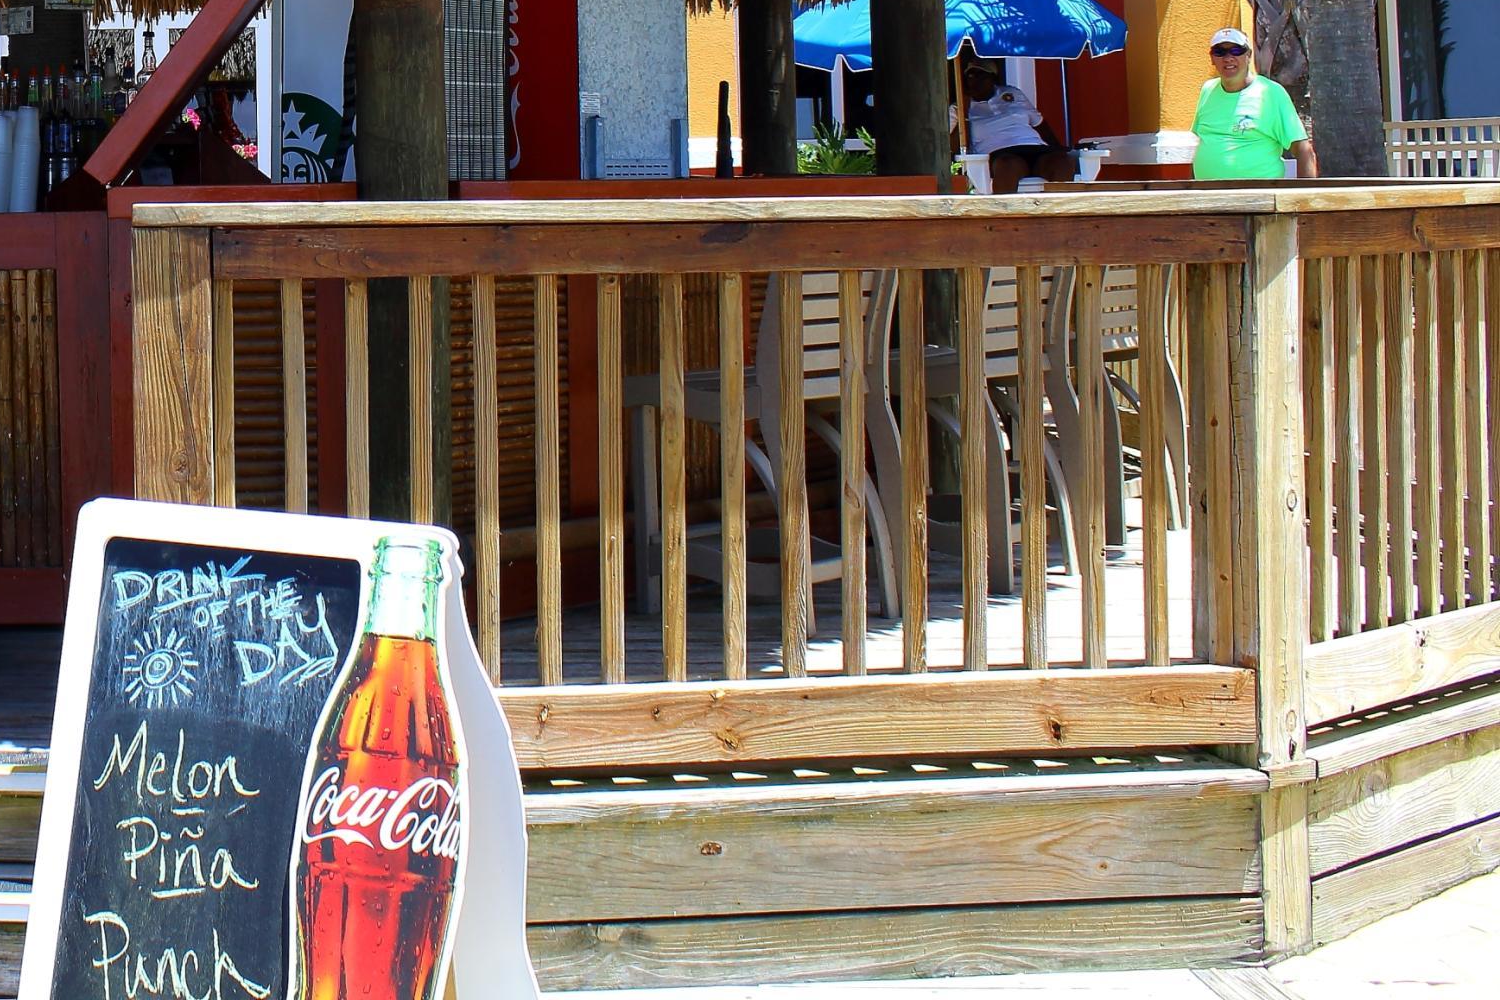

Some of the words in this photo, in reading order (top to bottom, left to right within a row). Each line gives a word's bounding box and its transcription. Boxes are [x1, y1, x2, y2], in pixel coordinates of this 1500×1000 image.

[112, 556, 266, 612] DRINK
[192, 601, 230, 629] OF
[238, 577, 303, 622] THE
[233, 592, 338, 686] DAY
[94, 720, 260, 801] Melon
[116, 816, 260, 890] Piña
[301, 765, 460, 860] Coca-Cola
[83, 911, 271, 1000] Punch
